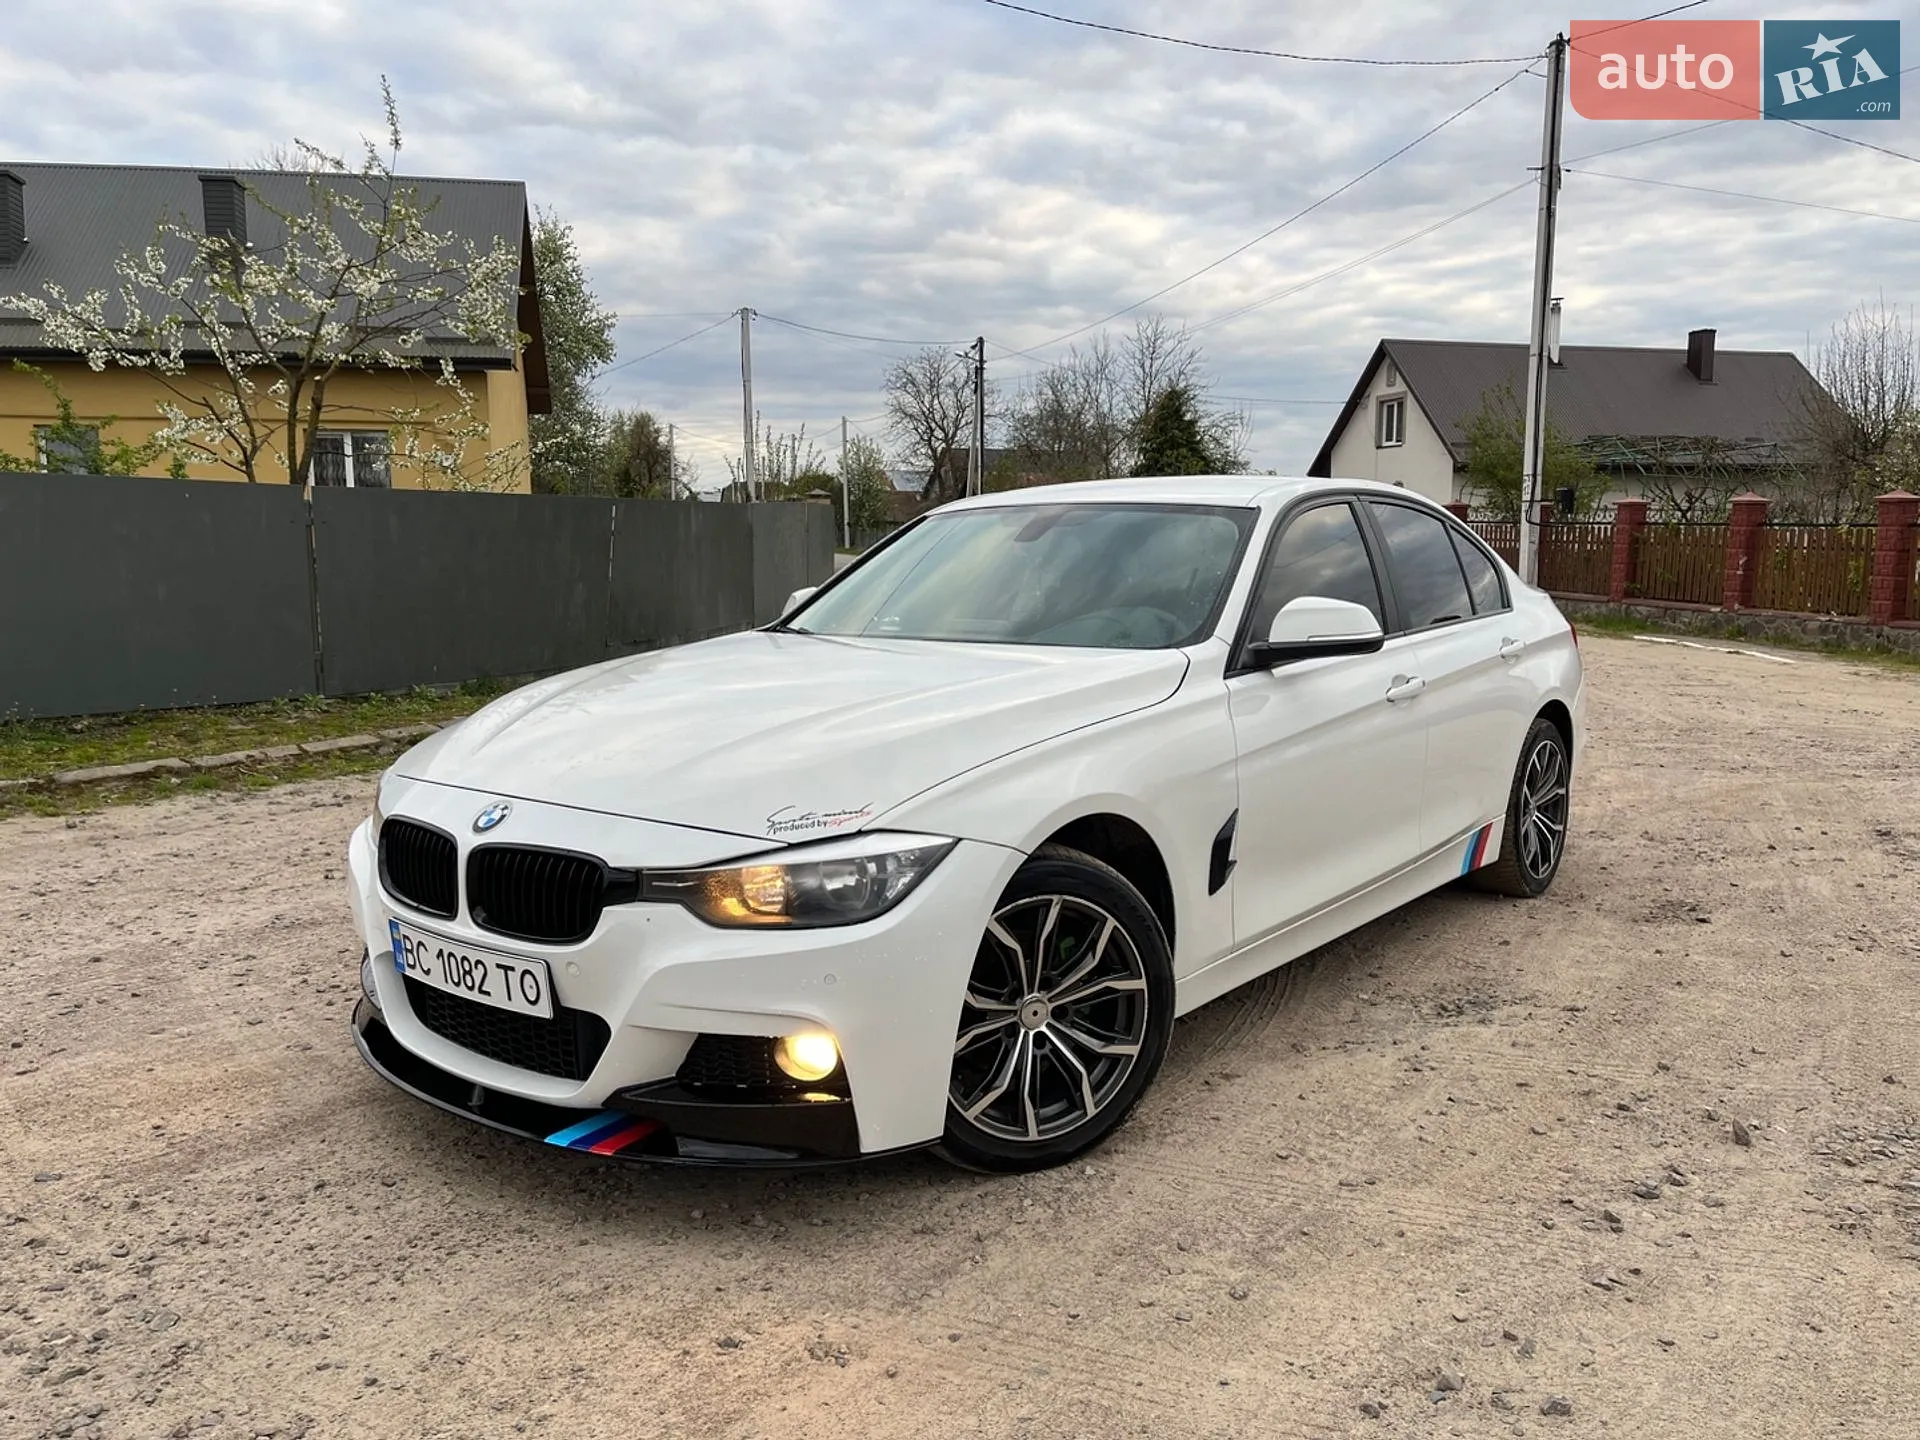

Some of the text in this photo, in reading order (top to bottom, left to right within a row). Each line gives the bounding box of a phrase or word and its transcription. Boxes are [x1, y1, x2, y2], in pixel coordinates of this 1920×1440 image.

[773, 818, 816, 835] produced
[817, 818, 829, 830] by
[402, 933, 541, 1006] BC 1082 TO
